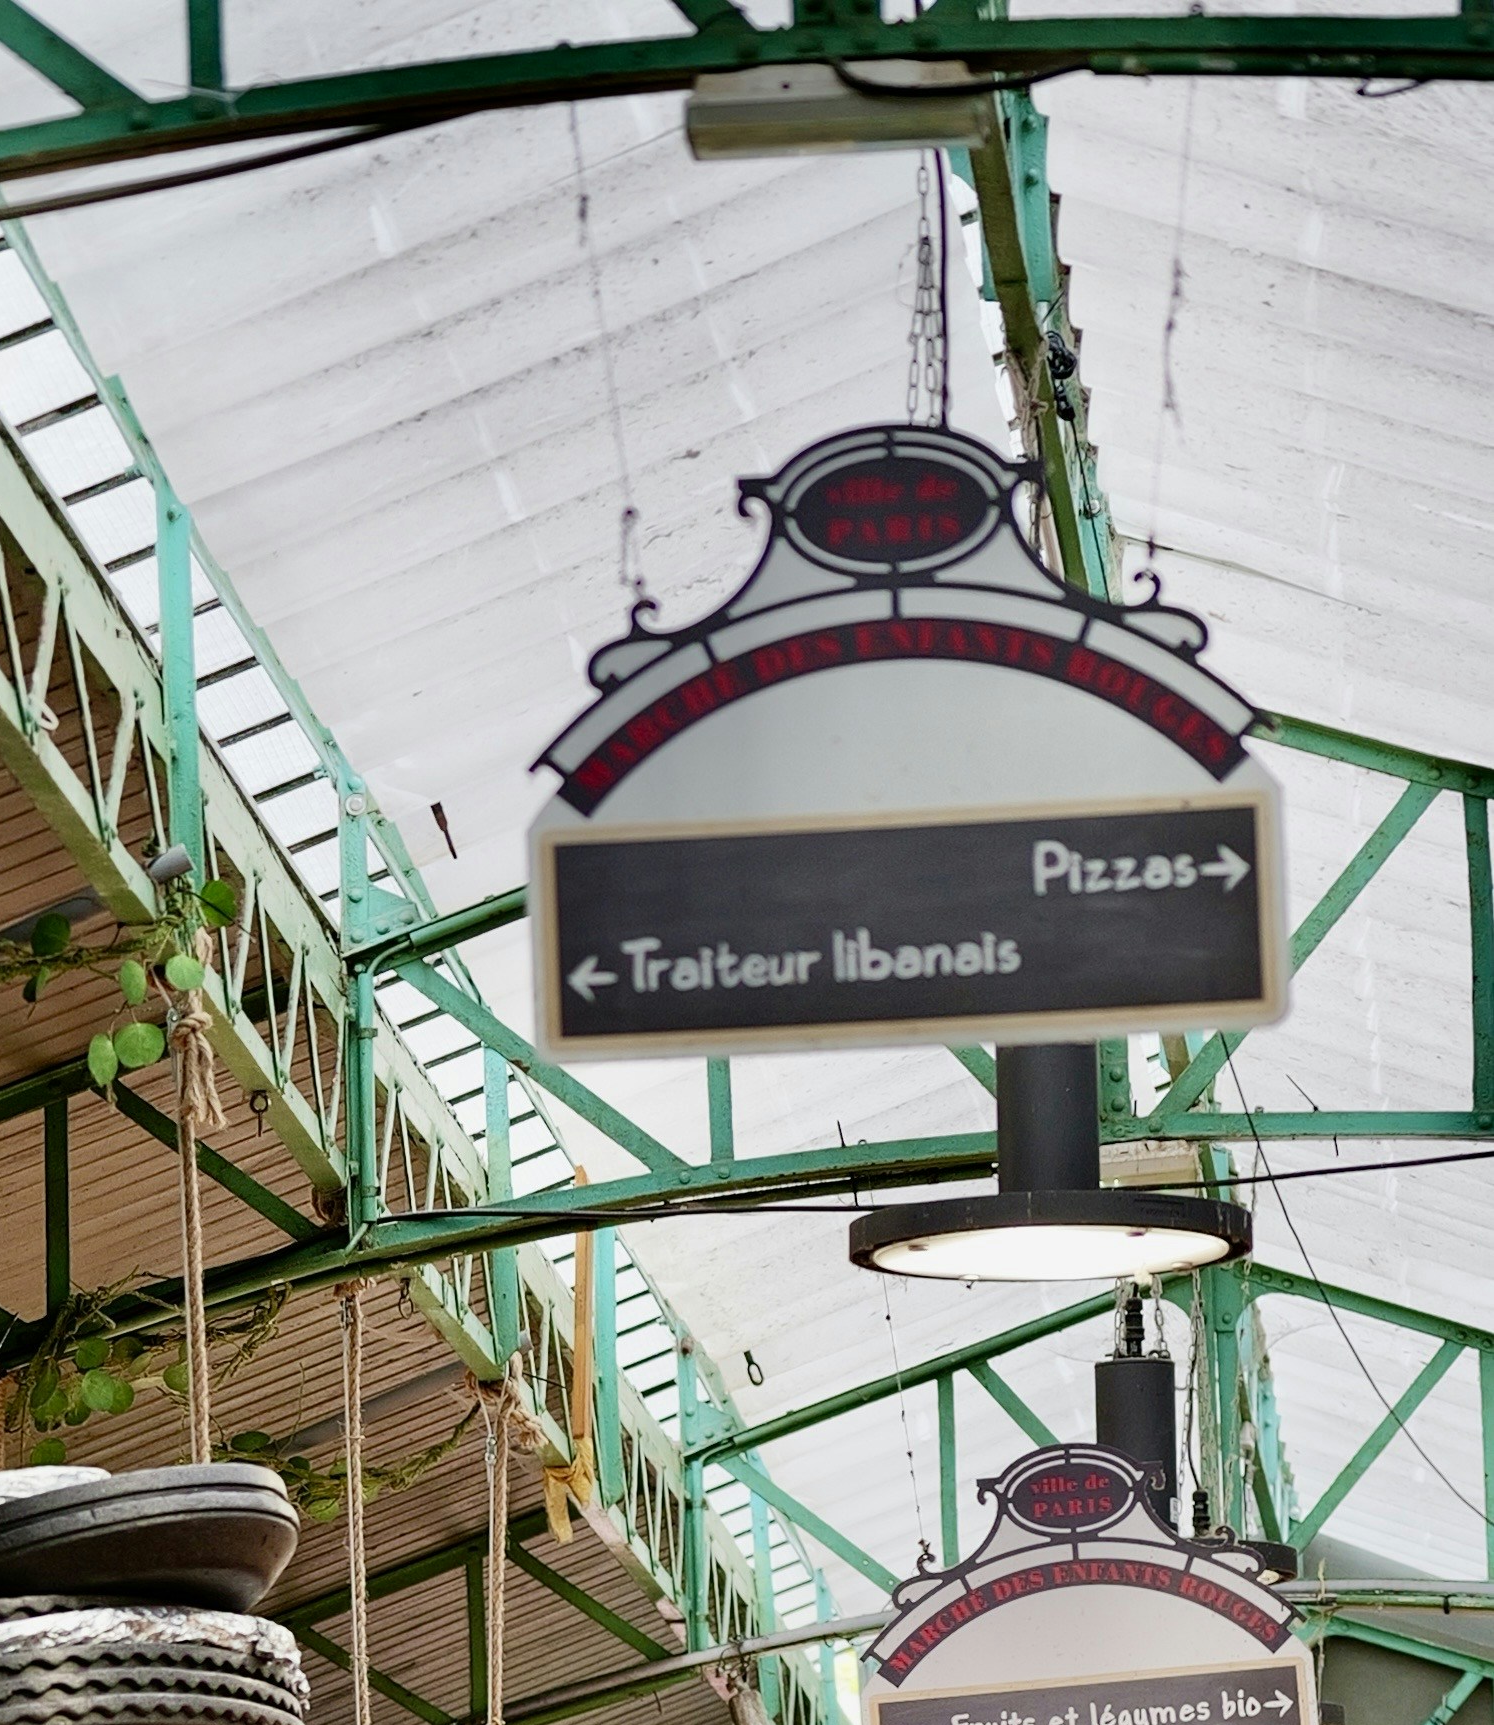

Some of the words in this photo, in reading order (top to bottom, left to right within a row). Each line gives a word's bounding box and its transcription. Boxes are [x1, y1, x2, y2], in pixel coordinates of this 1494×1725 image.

[827, 512, 960, 547] PARIS
[754, 633, 842, 683] DES
[858, 620, 1052, 668] ENFANTS
[1065, 648, 1227, 763] ROUGES
[1033, 840, 1198, 895] Pizzas
[621, 937, 822, 993] Traiteur
[833, 927, 1022, 982] libanais
[1030, 1477, 1078, 1494] ville
[1084, 1474, 1110, 1490] de
[1033, 1496, 1113, 1519] PARIS
[992, 1568, 1045, 1601] DES
[1051, 1560, 1173, 1589] ENFANTS
[1178, 1575, 1280, 1642] ROUGES
[1221, 1689, 1262, 1720] bio
